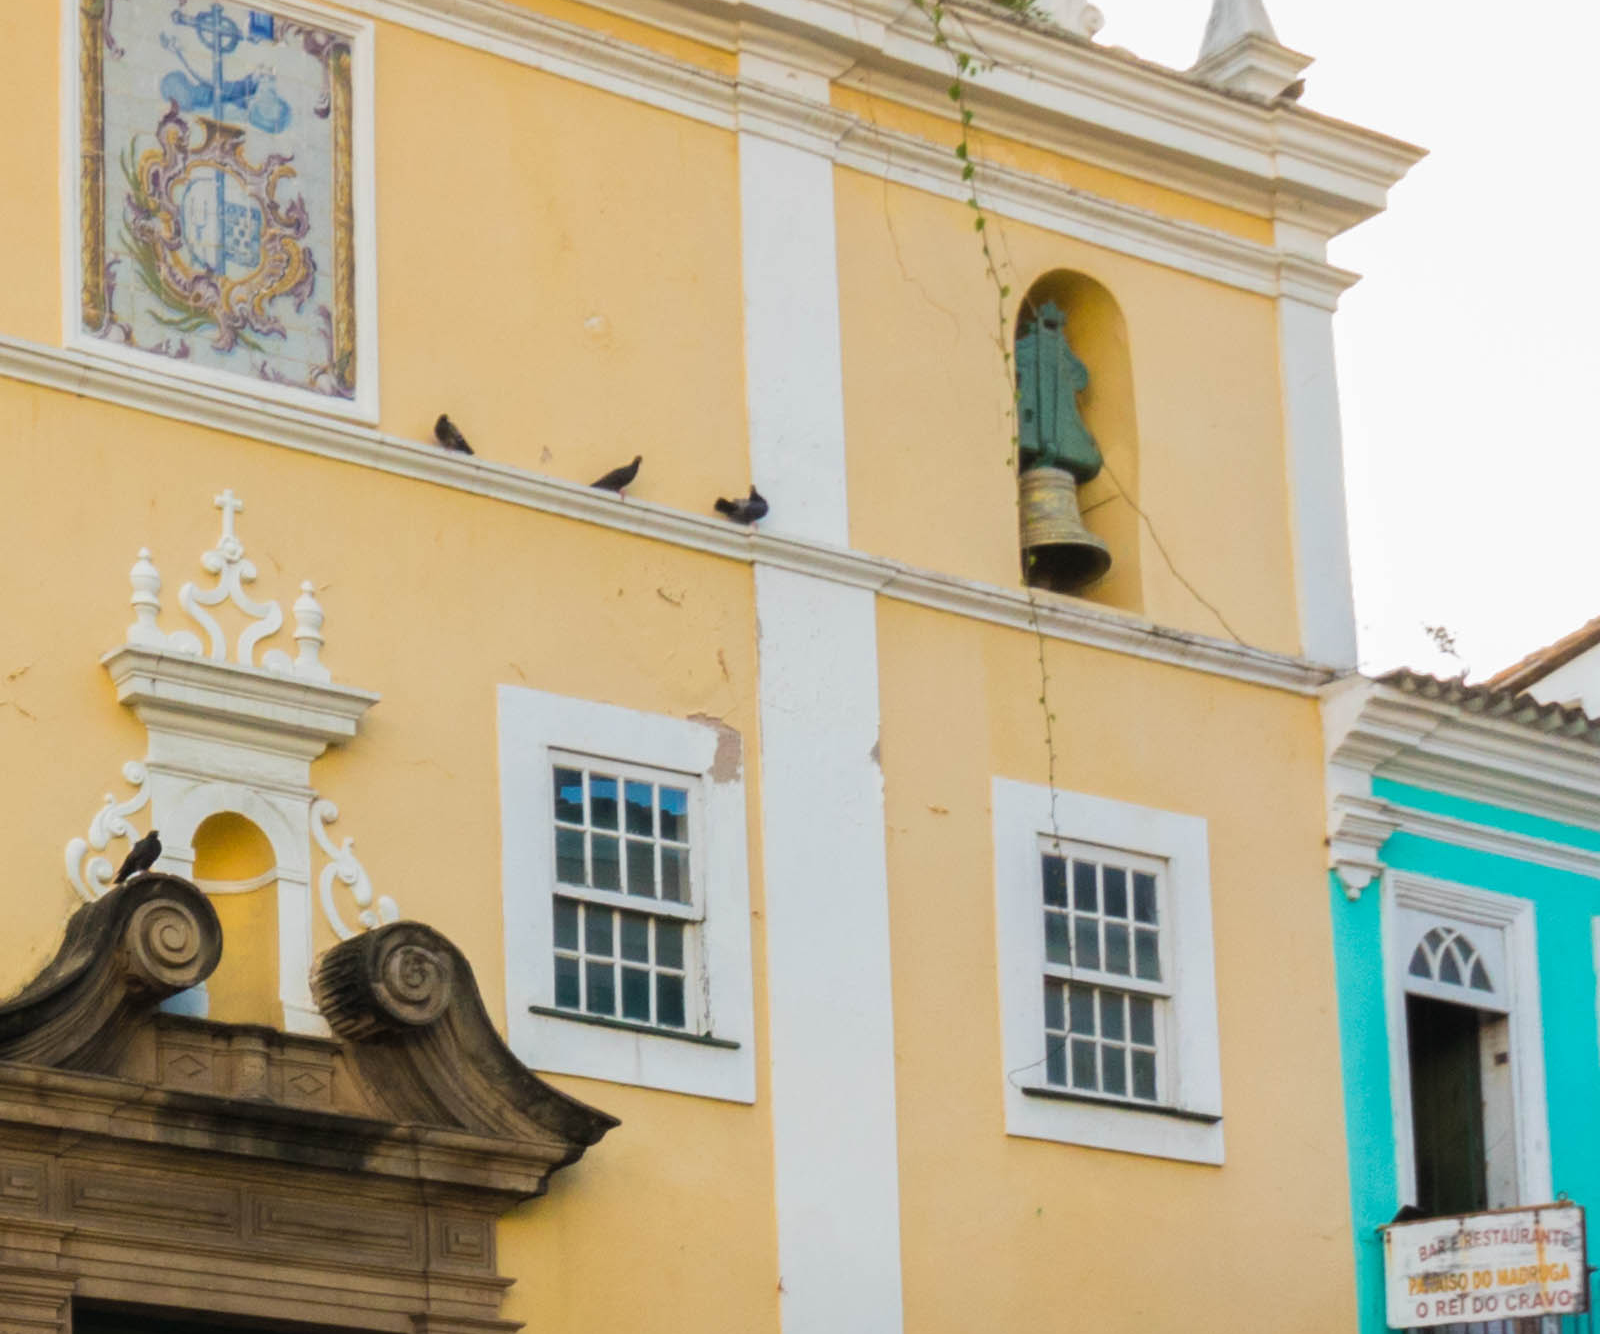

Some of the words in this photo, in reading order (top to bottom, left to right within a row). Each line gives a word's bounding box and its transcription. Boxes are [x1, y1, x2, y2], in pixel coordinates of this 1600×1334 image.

[1418, 1238, 1446, 1262] BAR
[1416, 1302, 1429, 1318] O
[1472, 1294, 1499, 1314] DO
[1505, 1289, 1572, 1312] CRAVO
